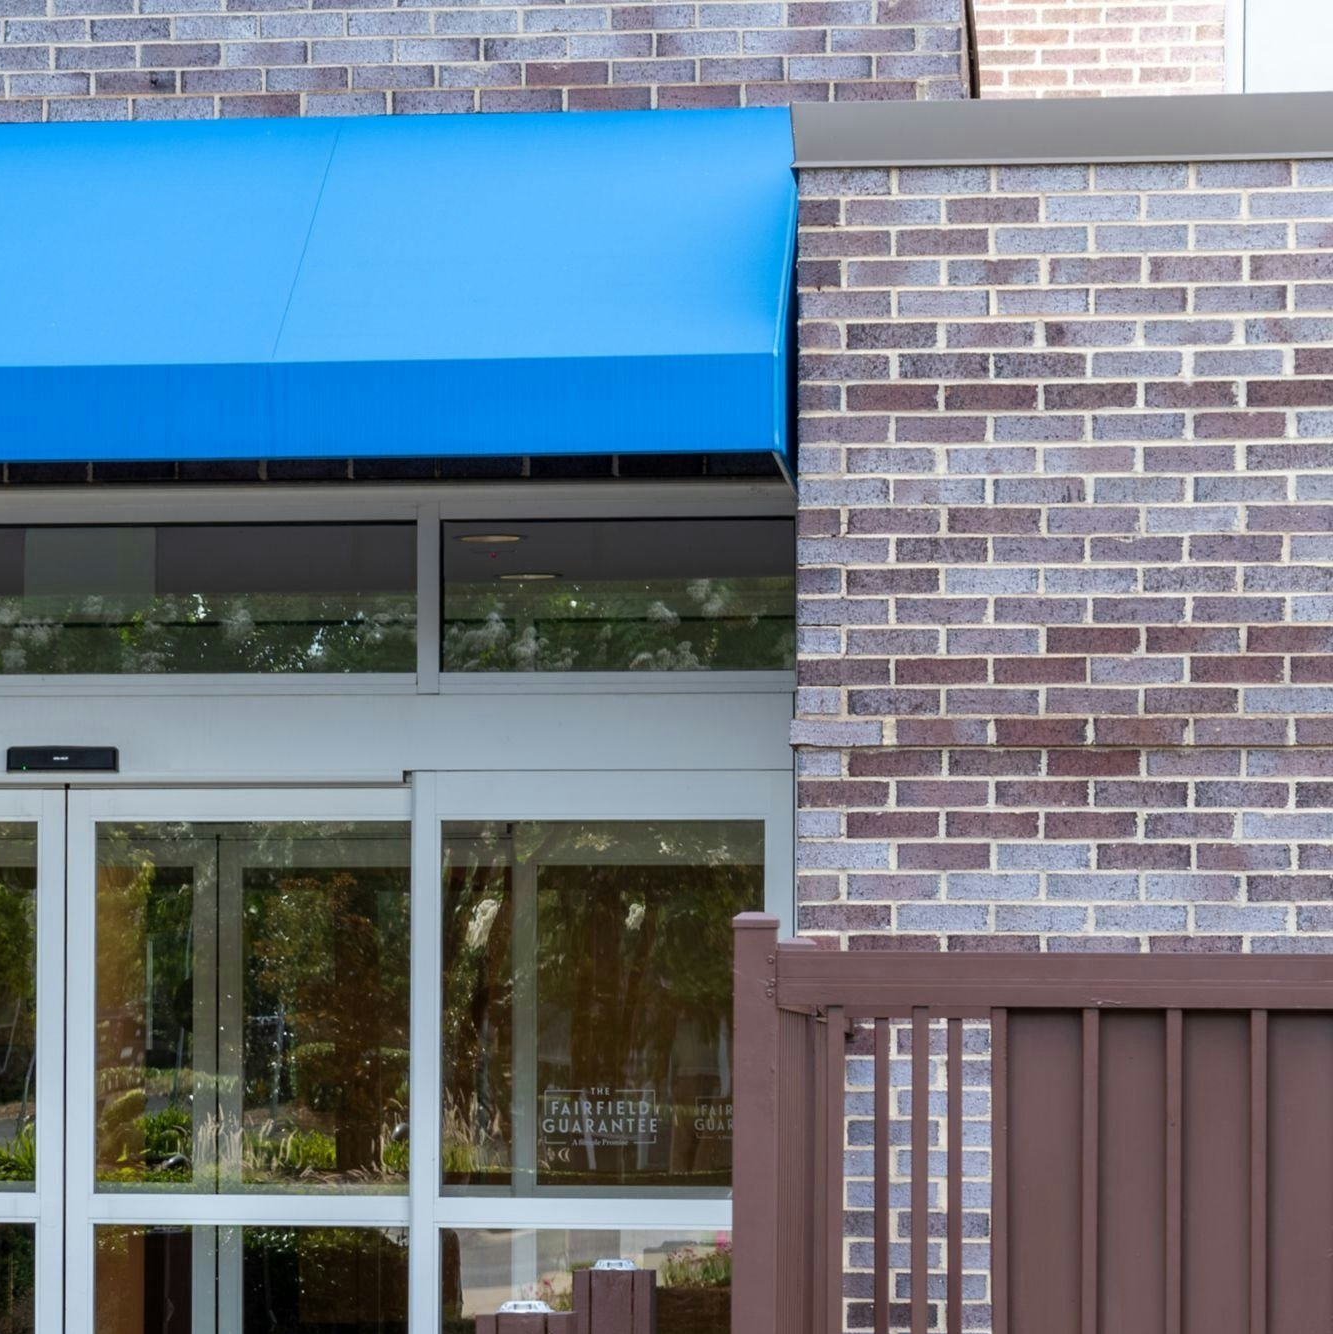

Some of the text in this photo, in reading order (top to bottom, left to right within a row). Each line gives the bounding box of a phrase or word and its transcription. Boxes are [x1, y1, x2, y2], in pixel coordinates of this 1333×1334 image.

[590, 1087, 611, 1096] THE
[551, 1100, 650, 1116] FAIRFIELD
[542, 1118, 658, 1134] GUARANTEE
